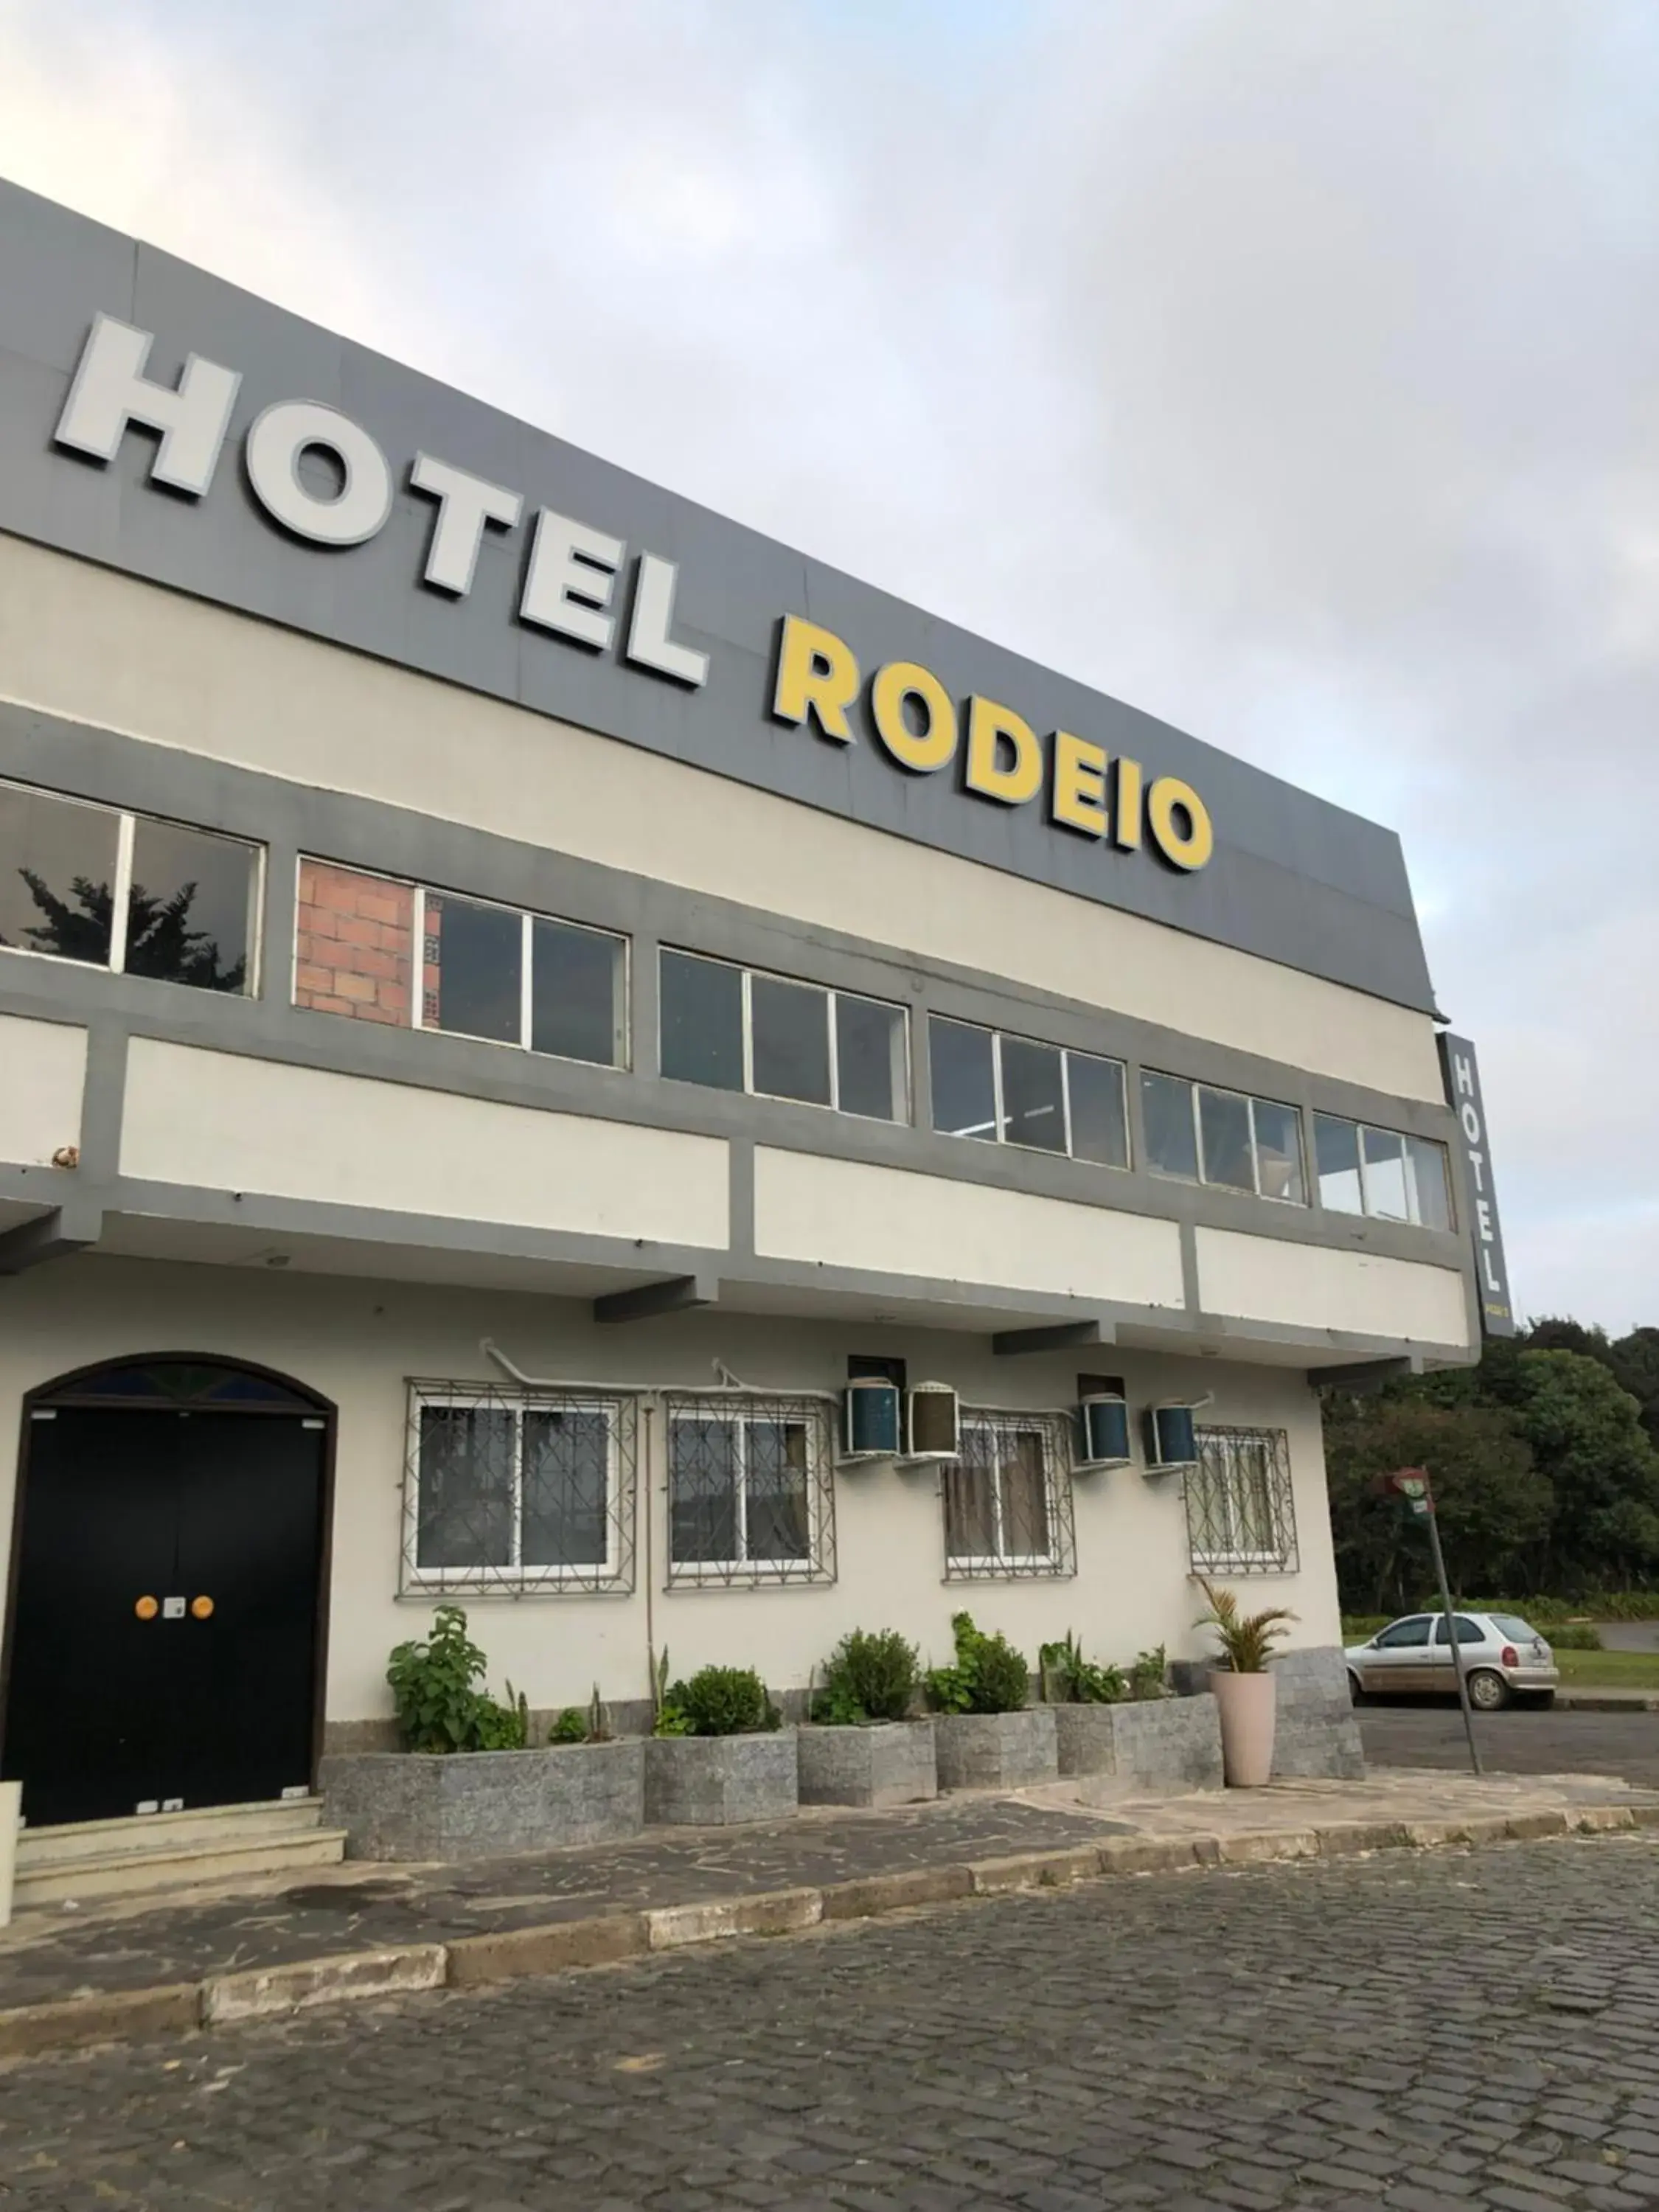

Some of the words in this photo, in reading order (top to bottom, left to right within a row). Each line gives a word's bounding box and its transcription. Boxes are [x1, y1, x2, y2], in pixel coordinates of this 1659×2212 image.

[54, 310, 710, 687] HOTEL
[772, 613, 1213, 871] RODEIO
[1455, 1053, 1500, 1292] HOTEL
